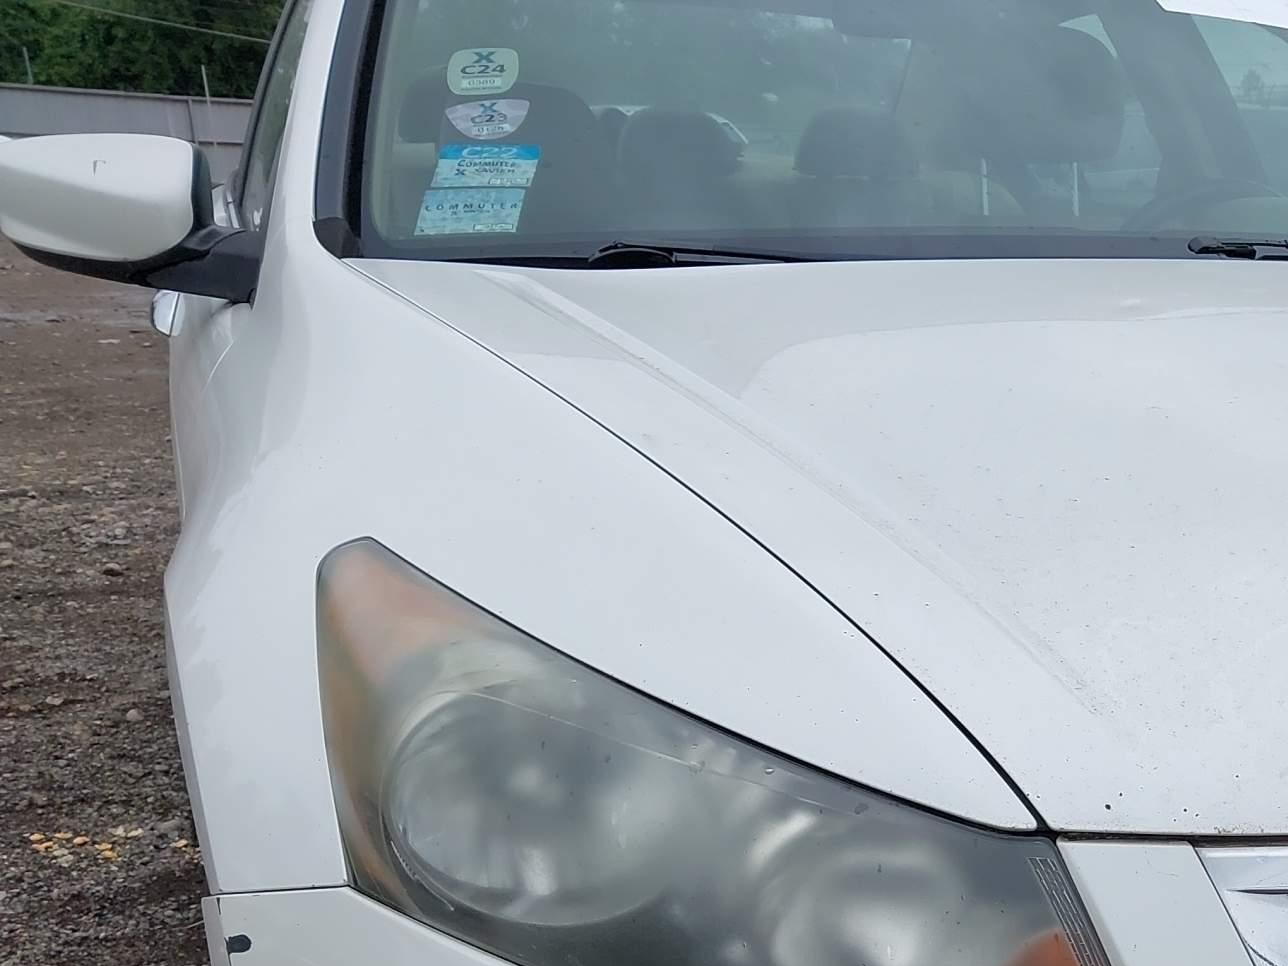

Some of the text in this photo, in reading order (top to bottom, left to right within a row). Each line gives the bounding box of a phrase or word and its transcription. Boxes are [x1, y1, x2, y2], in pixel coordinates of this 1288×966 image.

[460, 64, 507, 75] C24
[470, 112, 508, 124] C23
[461, 146, 518, 158] C22
